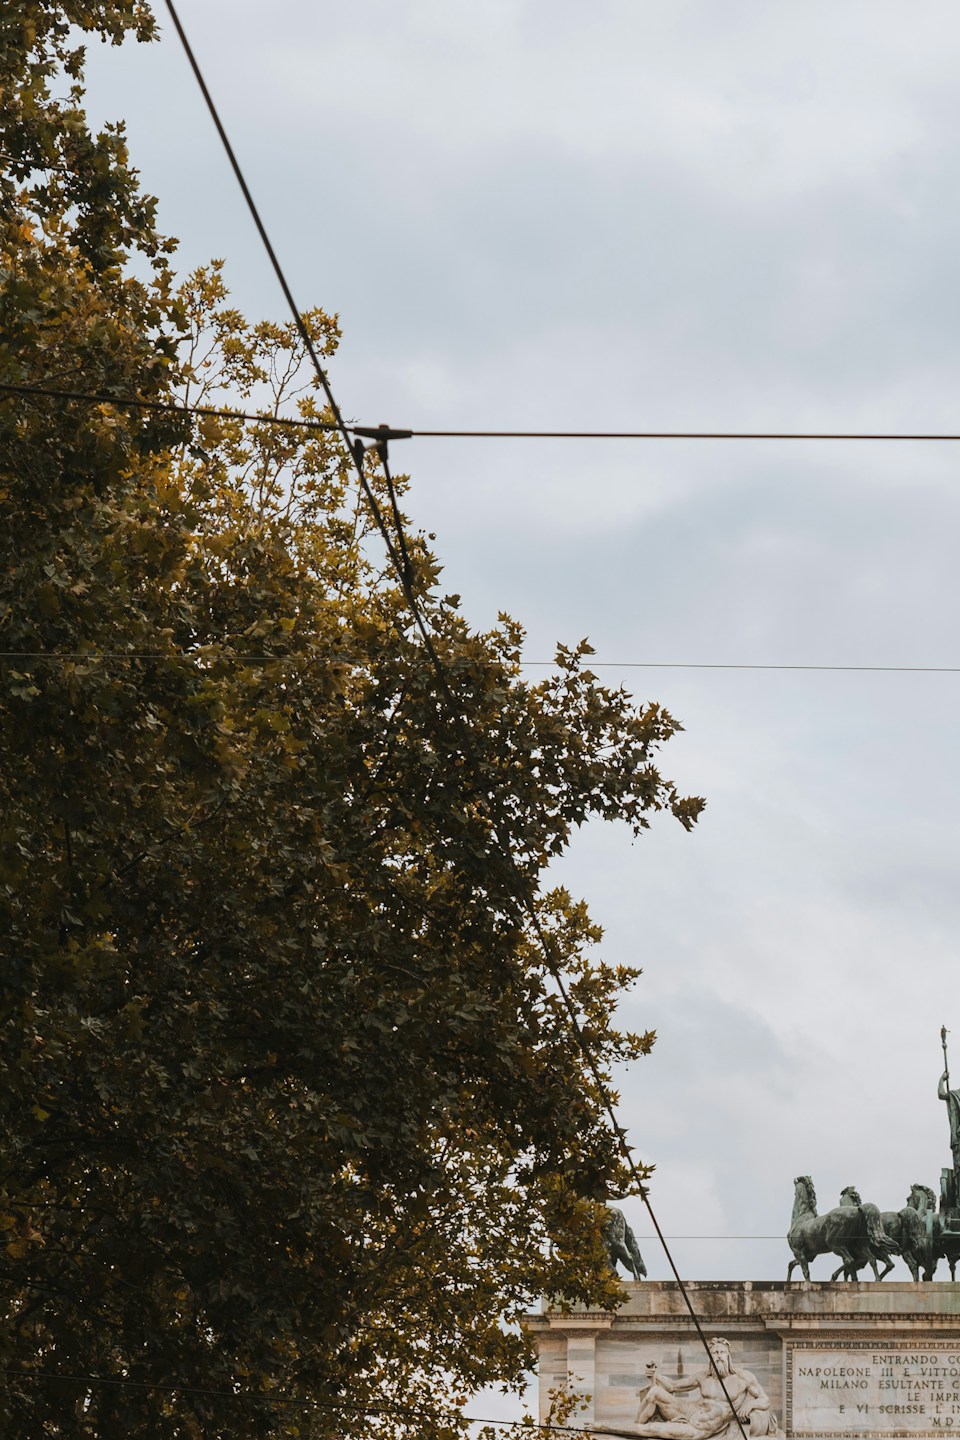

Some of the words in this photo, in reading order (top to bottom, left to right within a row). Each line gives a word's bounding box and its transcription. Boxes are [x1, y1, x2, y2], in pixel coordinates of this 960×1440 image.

[872, 1355, 938, 1365] ENTRANDO
[798, 1367, 871, 1377] NAPOLEONE
[881, 1367, 894, 1377] III
[903, 1367, 911, 1377] E
[820, 1379, 869, 1390] MILANO
[878, 1379, 944, 1390] ESULTANTE
[907, 1392, 921, 1402] LE
[838, 1404, 846, 1414] E
[857, 1404, 870, 1414] VI
[879, 1404, 926, 1414] SCRISSE
